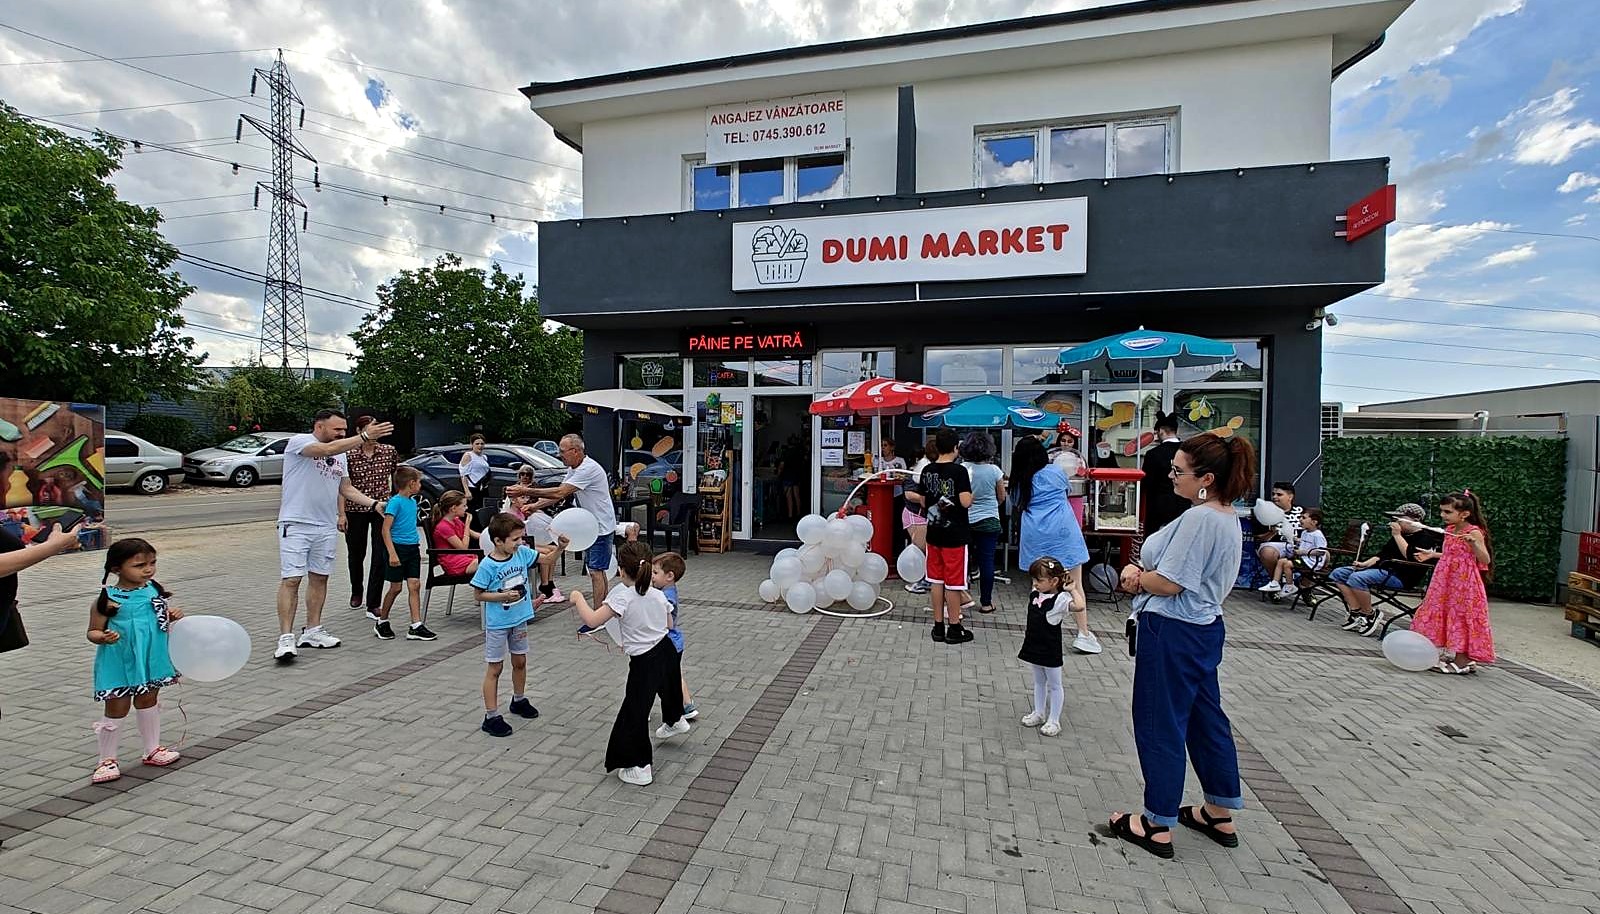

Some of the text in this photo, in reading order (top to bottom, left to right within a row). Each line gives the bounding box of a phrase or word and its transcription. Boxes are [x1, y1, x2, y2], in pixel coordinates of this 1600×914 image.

[711, 100, 844, 126] ANGAJEZ VÂNZĂTOARE
[724, 122, 826, 144] TEL: 0745.390.612
[822, 224, 1071, 264] DUMI MARKET
[688, 331, 803, 351] PÂINE PE VATRĂ
